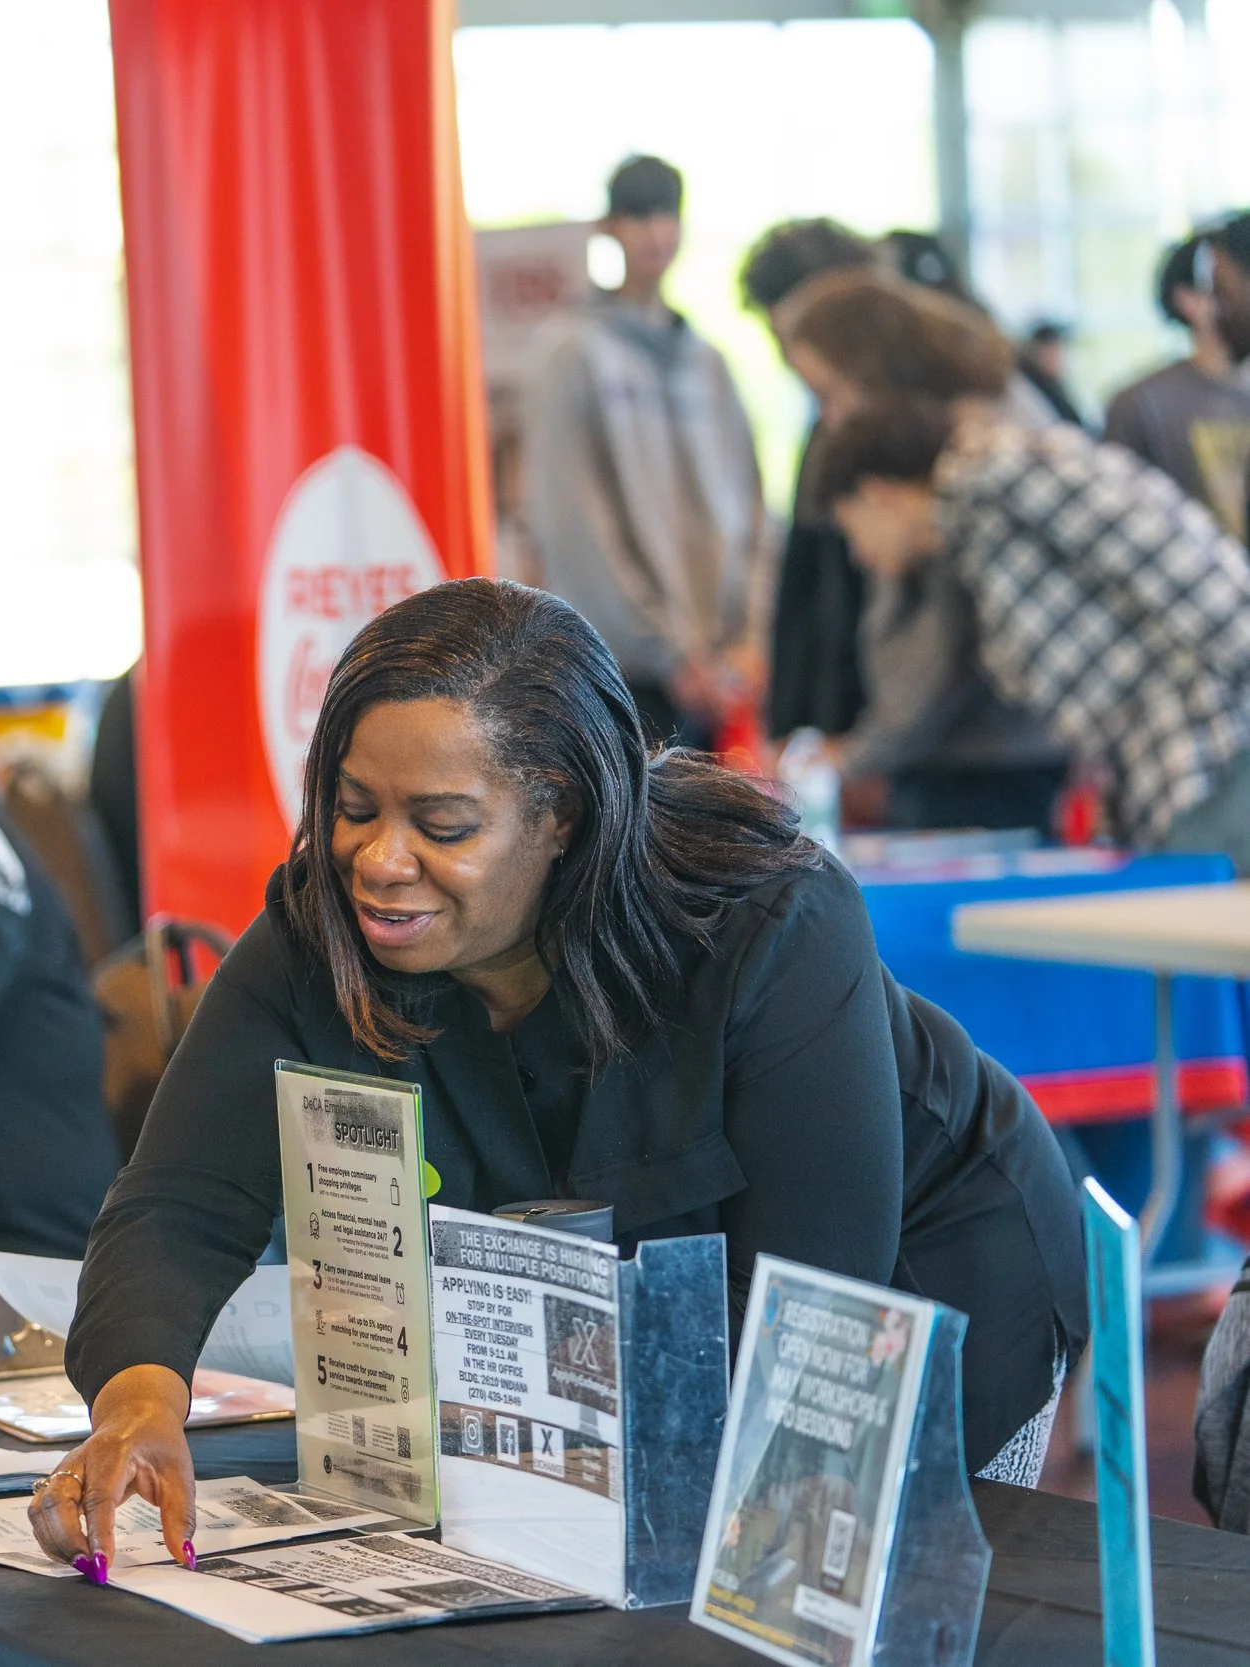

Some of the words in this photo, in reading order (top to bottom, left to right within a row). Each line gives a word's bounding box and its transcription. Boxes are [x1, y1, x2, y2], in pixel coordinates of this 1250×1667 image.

[303, 1096, 323, 1111] DeCA
[335, 1122, 399, 1150] SPOTLIGHT
[307, 1163, 314, 1192] 1
[318, 1164, 327, 1173] Free
[329, 1166, 350, 1177] employee
[351, 1170, 377, 1183] commissary
[319, 1177, 339, 1189] shopping
[340, 1181, 361, 1192] privileges
[321, 1209, 336, 1218] Access
[357, 1216, 372, 1225] mental
[373, 1219, 387, 1228] health
[333, 1224, 341, 1232] and
[343, 1225, 353, 1235] legal
[354, 1229, 376, 1239] assistance
[393, 1226, 403, 1257] 2
[459, 1230, 481, 1248] THE
[484, 1234, 542, 1259] EXCHANGE
[545, 1243, 558, 1261] IS
[560, 1247, 609, 1276] HIRING
[312, 1259, 323, 1289] 3
[324, 1263, 336, 1275] Carry
[337, 1267, 347, 1275] over
[347, 1269, 363, 1279] unused
[364, 1272, 378, 1282] annual
[379, 1274, 391, 1284] leave
[460, 1249, 483, 1267] FOR
[486, 1253, 539, 1277] MULTIPLE
[541, 1261, 609, 1294] POSITIONS
[442, 1276, 491, 1297] APPLYING
[493, 1283, 504, 1298] IS
[506, 1286, 533, 1304] EASY!
[467, 1299, 485, 1312] STOP
[487, 1302, 496, 1313] BY
[498, 1304, 512, 1317] FOR
[331, 1324, 351, 1336] matching
[359, 1331, 369, 1339] your
[348, 1315, 356, 1324] Get
[357, 1318, 362, 1326] up
[377, 1323, 392, 1333] agency
[445, 1313, 491, 1329] ON-THE-SPOT
[492, 1319, 534, 1337] INTERVIEWS
[783, 1300, 872, 1348] REGISTRATION
[397, 1327, 408, 1356] 4
[465, 1328, 487, 1342] EVERY
[488, 1332, 519, 1347] TUESDAY
[467, 1343, 488, 1357] FROM
[488, 1346, 505, 1360] 9-11
[507, 1350, 518, 1362] AM
[779, 1332, 811, 1364] OPEN
[811, 1344, 843, 1374] NOW
[842, 1352, 870, 1385] FOR
[317, 1355, 327, 1385] 5
[329, 1358, 345, 1369] Receive
[347, 1361, 359, 1372] credit
[367, 1368, 377, 1376] your
[378, 1370, 395, 1382] military
[329, 1371, 344, 1381] service
[345, 1374, 362, 1385] towards
[463, 1356, 471, 1367] IN
[472, 1358, 485, 1370] THE
[487, 1361, 497, 1372] HR
[498, 1363, 523, 1378] OFFICE
[459, 1370, 480, 1384] BLDG.
[481, 1374, 499, 1388] 2610
[500, 1377, 528, 1394] INDIANA
[468, 1386, 487, 1401] (270)
